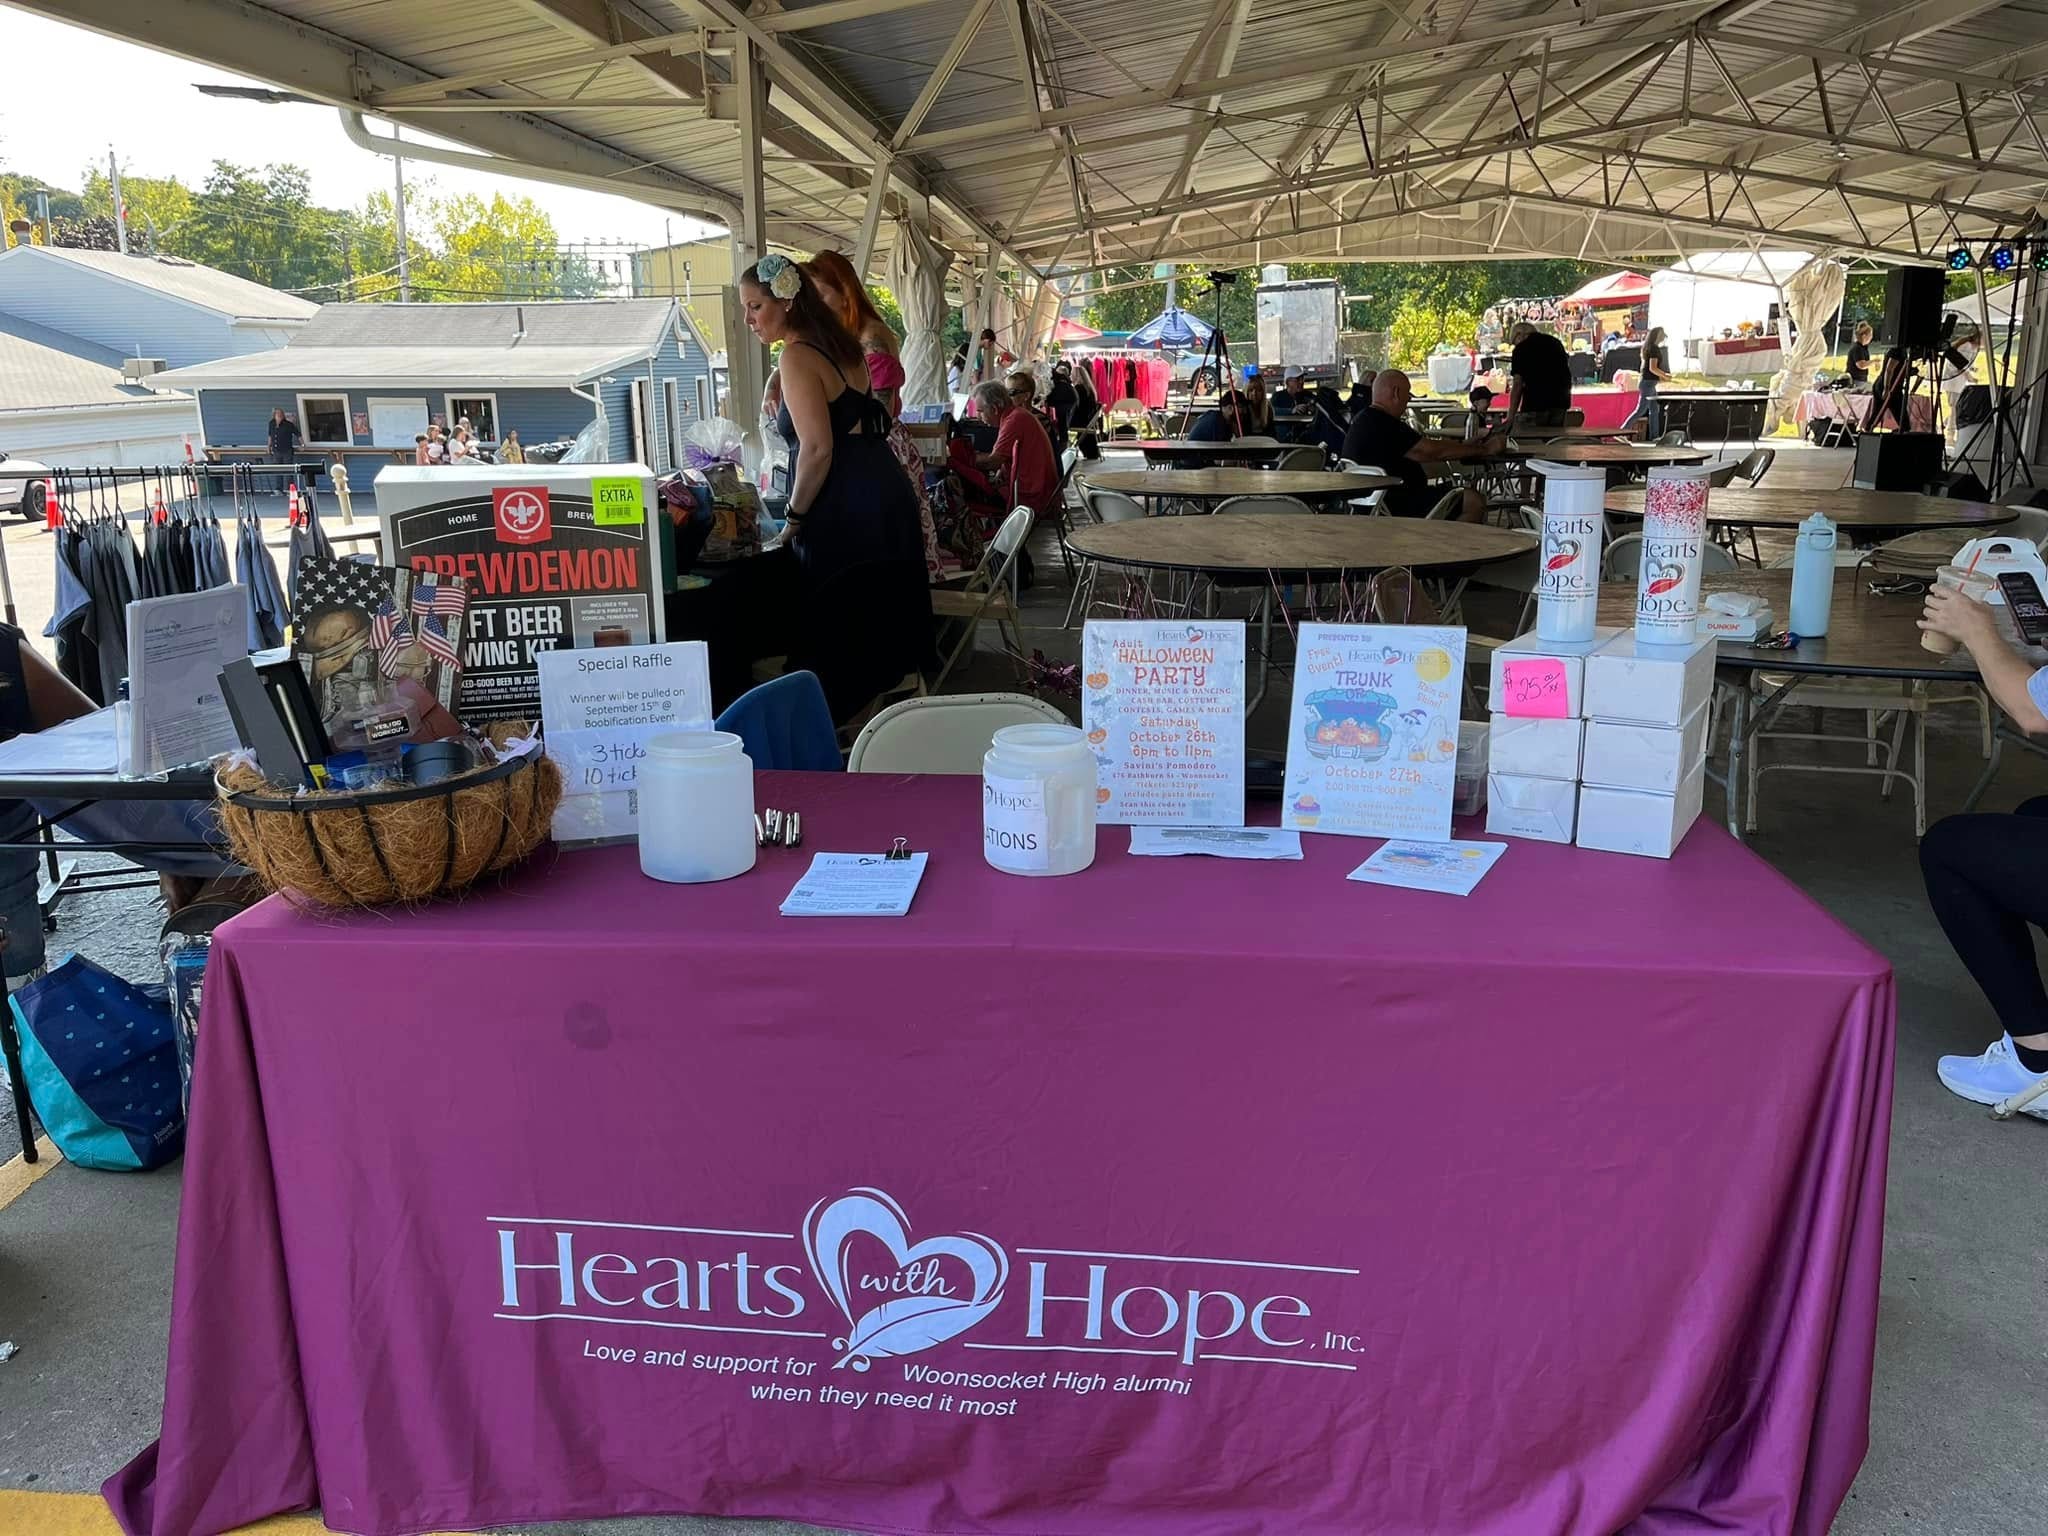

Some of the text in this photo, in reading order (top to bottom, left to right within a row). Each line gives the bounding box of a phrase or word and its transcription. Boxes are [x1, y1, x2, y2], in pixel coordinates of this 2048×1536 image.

[600, 489, 634, 503] EXTRA
[448, 513, 478, 526] HOME
[567, 510, 594, 521] BREW
[506, 605, 564, 637] BEER
[1707, 622, 1741, 631] DUNKIN'
[1113, 640, 1143, 648] Adult
[464, 640, 519, 667] WING
[578, 653, 672, 673] Special Raffle
[1134, 666, 1205, 686] PARTY
[1335, 671, 1393, 688] TRUNK
[570, 688, 685, 704] Winner will be pulled on
[586, 704, 638, 717] September
[662, 701, 672, 711] @
[585, 713, 676, 728] Boobification Event
[1140, 715, 1199, 729] Saturday
[1129, 730, 1216, 743] October 26th
[592, 744, 608, 762] 3
[1165, 746, 1179, 756] to
[584, 765, 638, 784] 10 tick
[1325, 765, 1423, 784] October 27th
[994, 791, 1032, 811] Hope
[498, 1230, 806, 1319] Hearts
[860, 1258, 956, 1296] with
[1323, 1330, 1366, 1353] Inc.
[584, 1339, 816, 1376] Love and support for
[903, 1364, 1193, 1396] Woonsocket High alumni
[751, 1382, 1018, 1416] when they need it most
